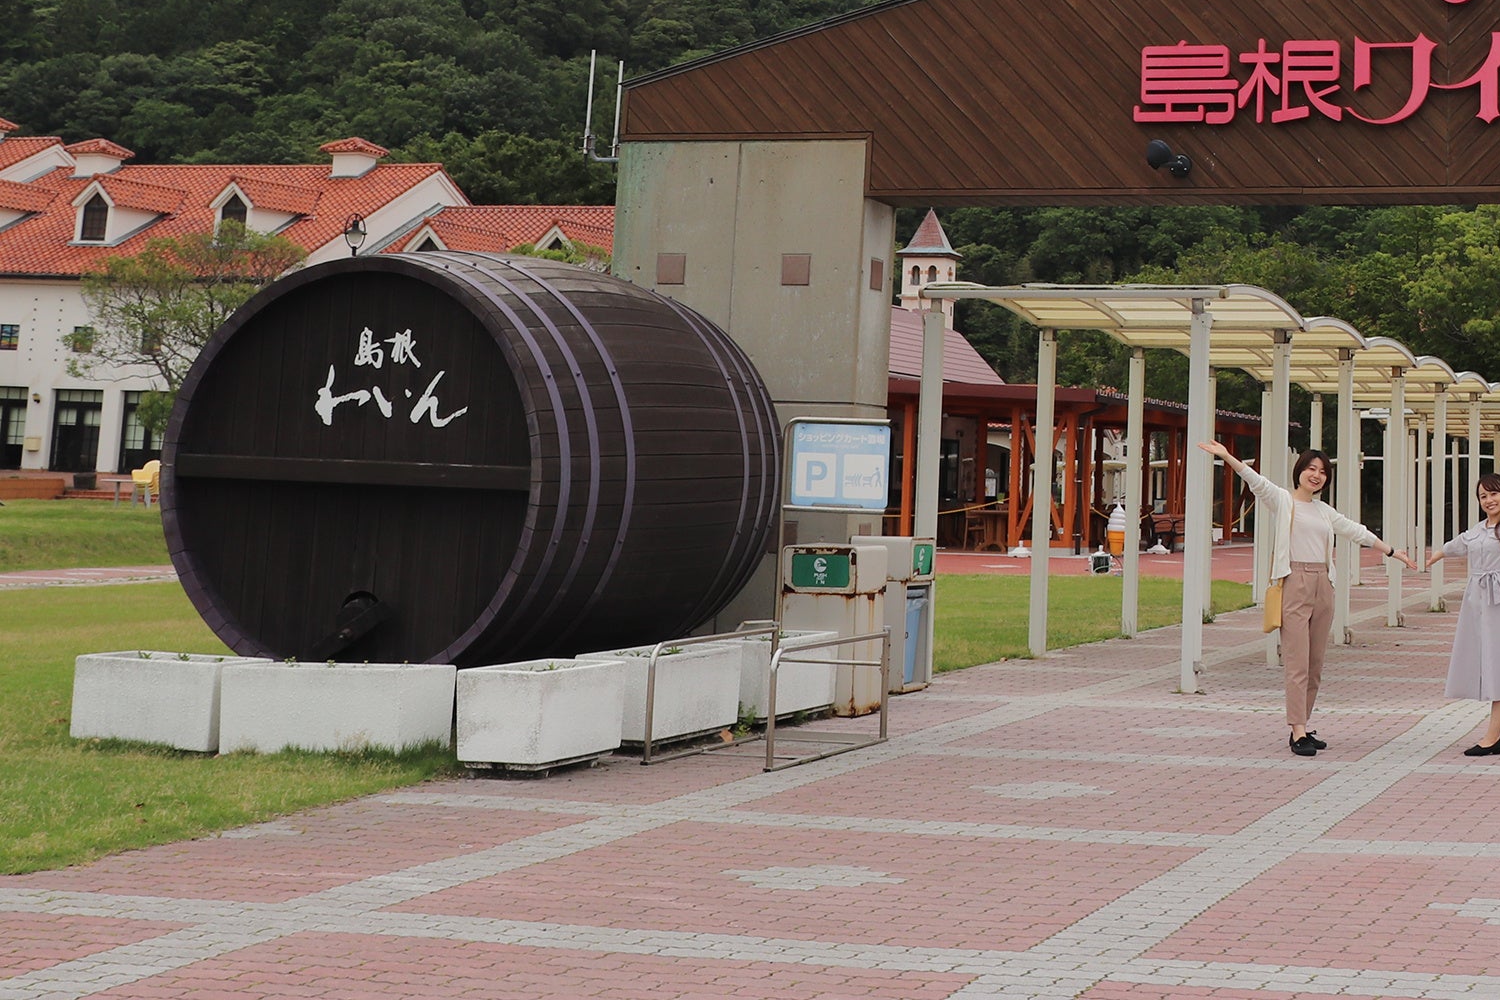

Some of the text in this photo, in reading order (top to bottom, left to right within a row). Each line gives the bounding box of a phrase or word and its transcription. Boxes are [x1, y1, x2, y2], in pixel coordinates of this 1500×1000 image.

[354, 327, 421, 369] 島根
[314, 364, 468, 428] わいん
[805, 460, 828, 491] P
